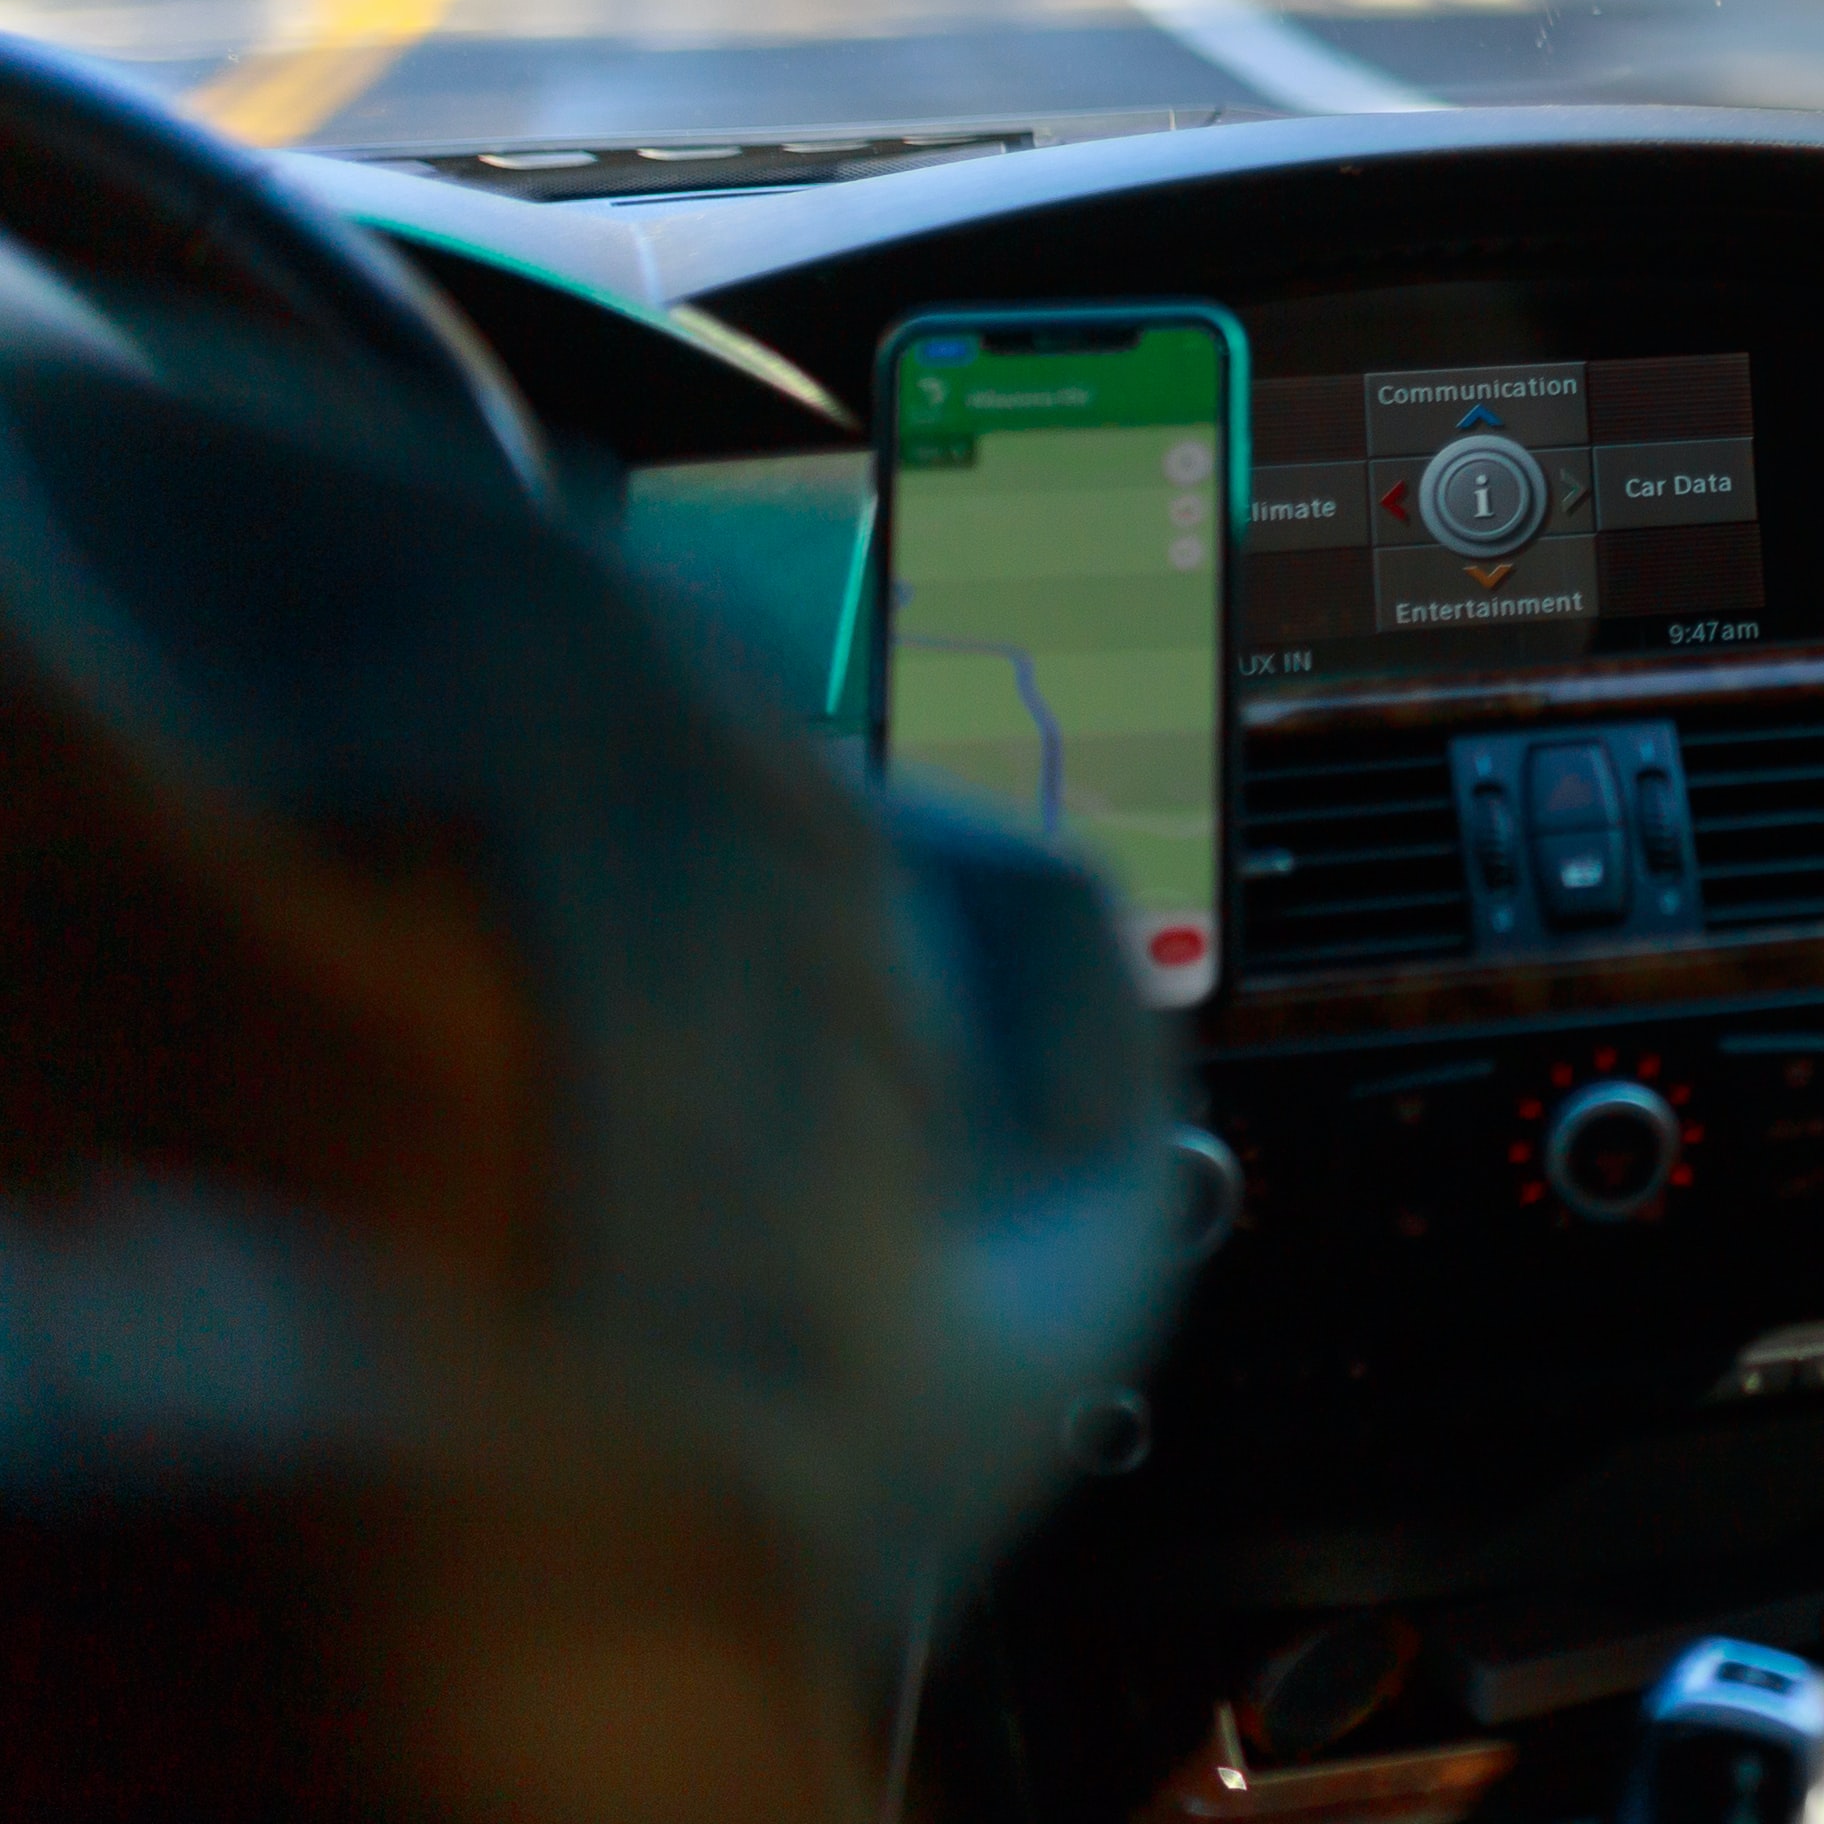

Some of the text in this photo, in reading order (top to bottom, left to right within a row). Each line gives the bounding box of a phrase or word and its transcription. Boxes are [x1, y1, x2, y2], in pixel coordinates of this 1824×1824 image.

[1377, 377, 1578, 405] Communication
[1625, 474, 1732, 498] Car Data
[1246, 498, 1337, 522] limate
[1395, 591, 1585, 624] Entertainment
[1668, 621, 1760, 645] 9:47am
[1238, 649, 1312, 676] UX IN
